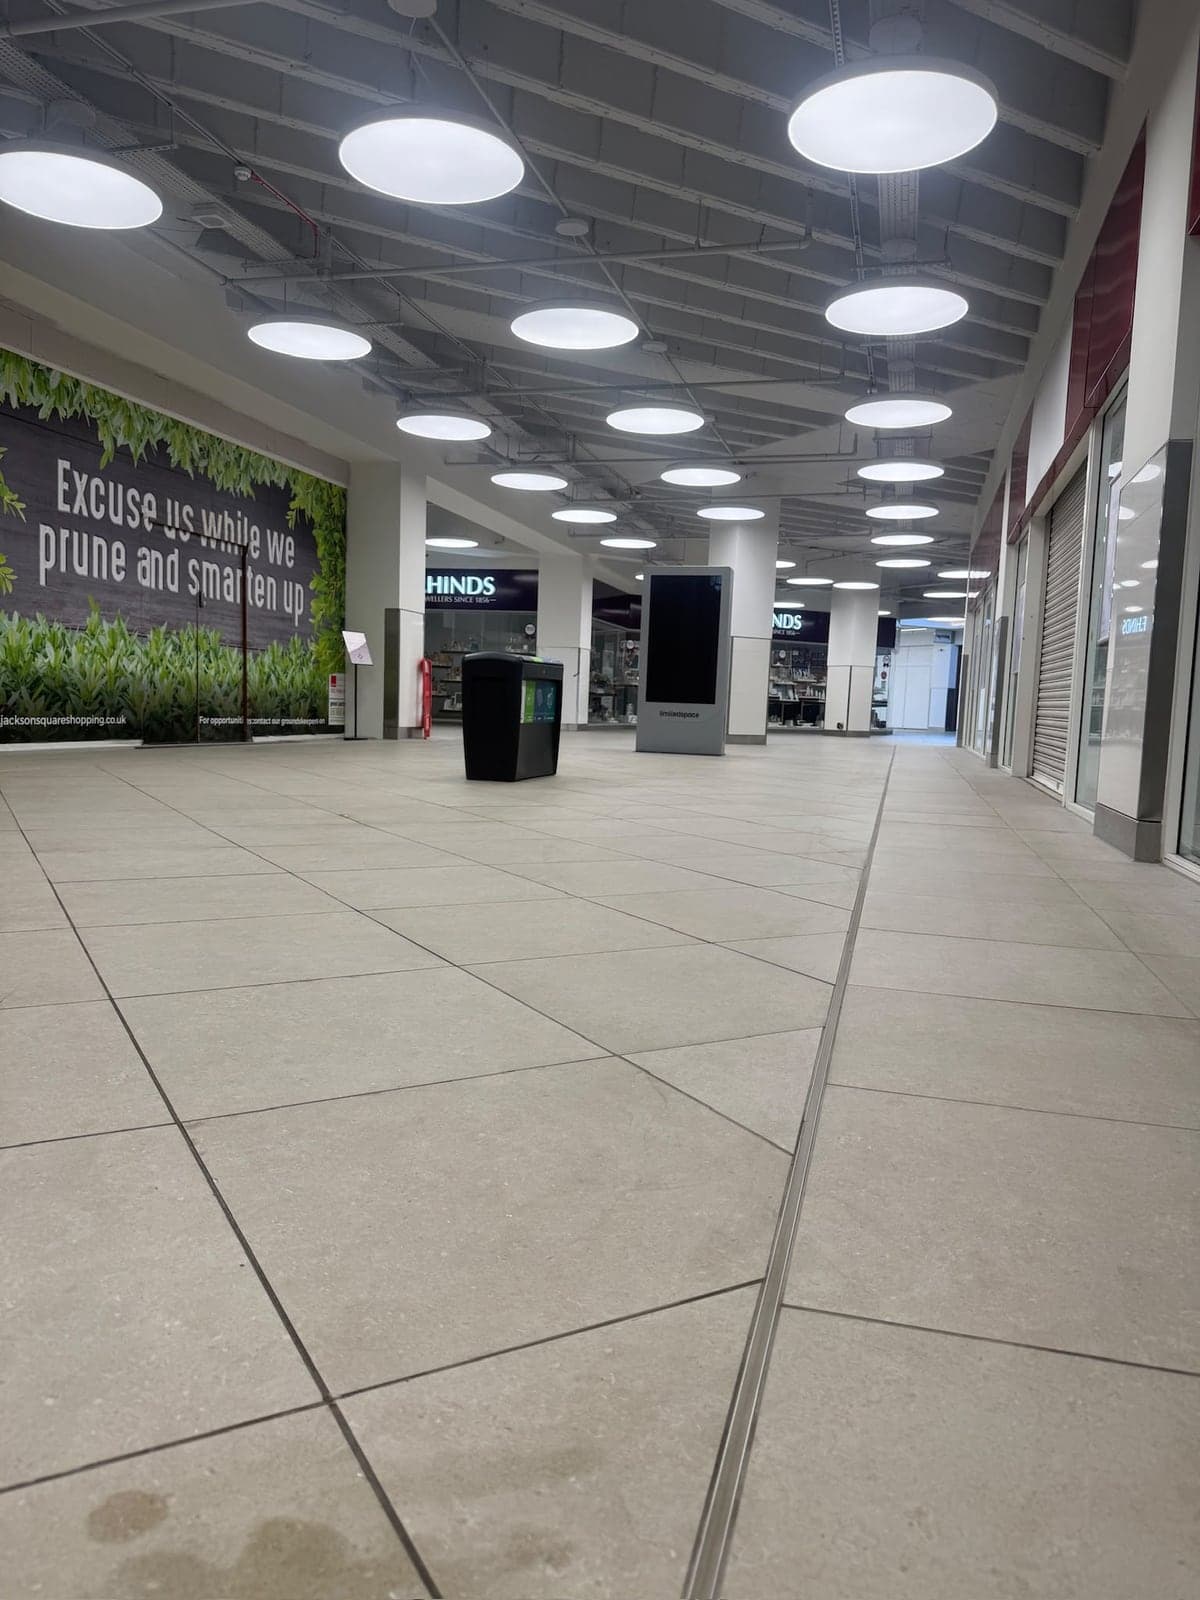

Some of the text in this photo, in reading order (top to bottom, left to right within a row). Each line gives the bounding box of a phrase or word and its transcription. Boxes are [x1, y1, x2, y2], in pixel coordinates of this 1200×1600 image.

[57, 458, 295, 568] Excuse us while we
[39, 523, 304, 627] prune and smarten up
[426, 576, 496, 595] HINDS
[772, 613, 802, 630] NDS
[199, 716, 209, 724] For
